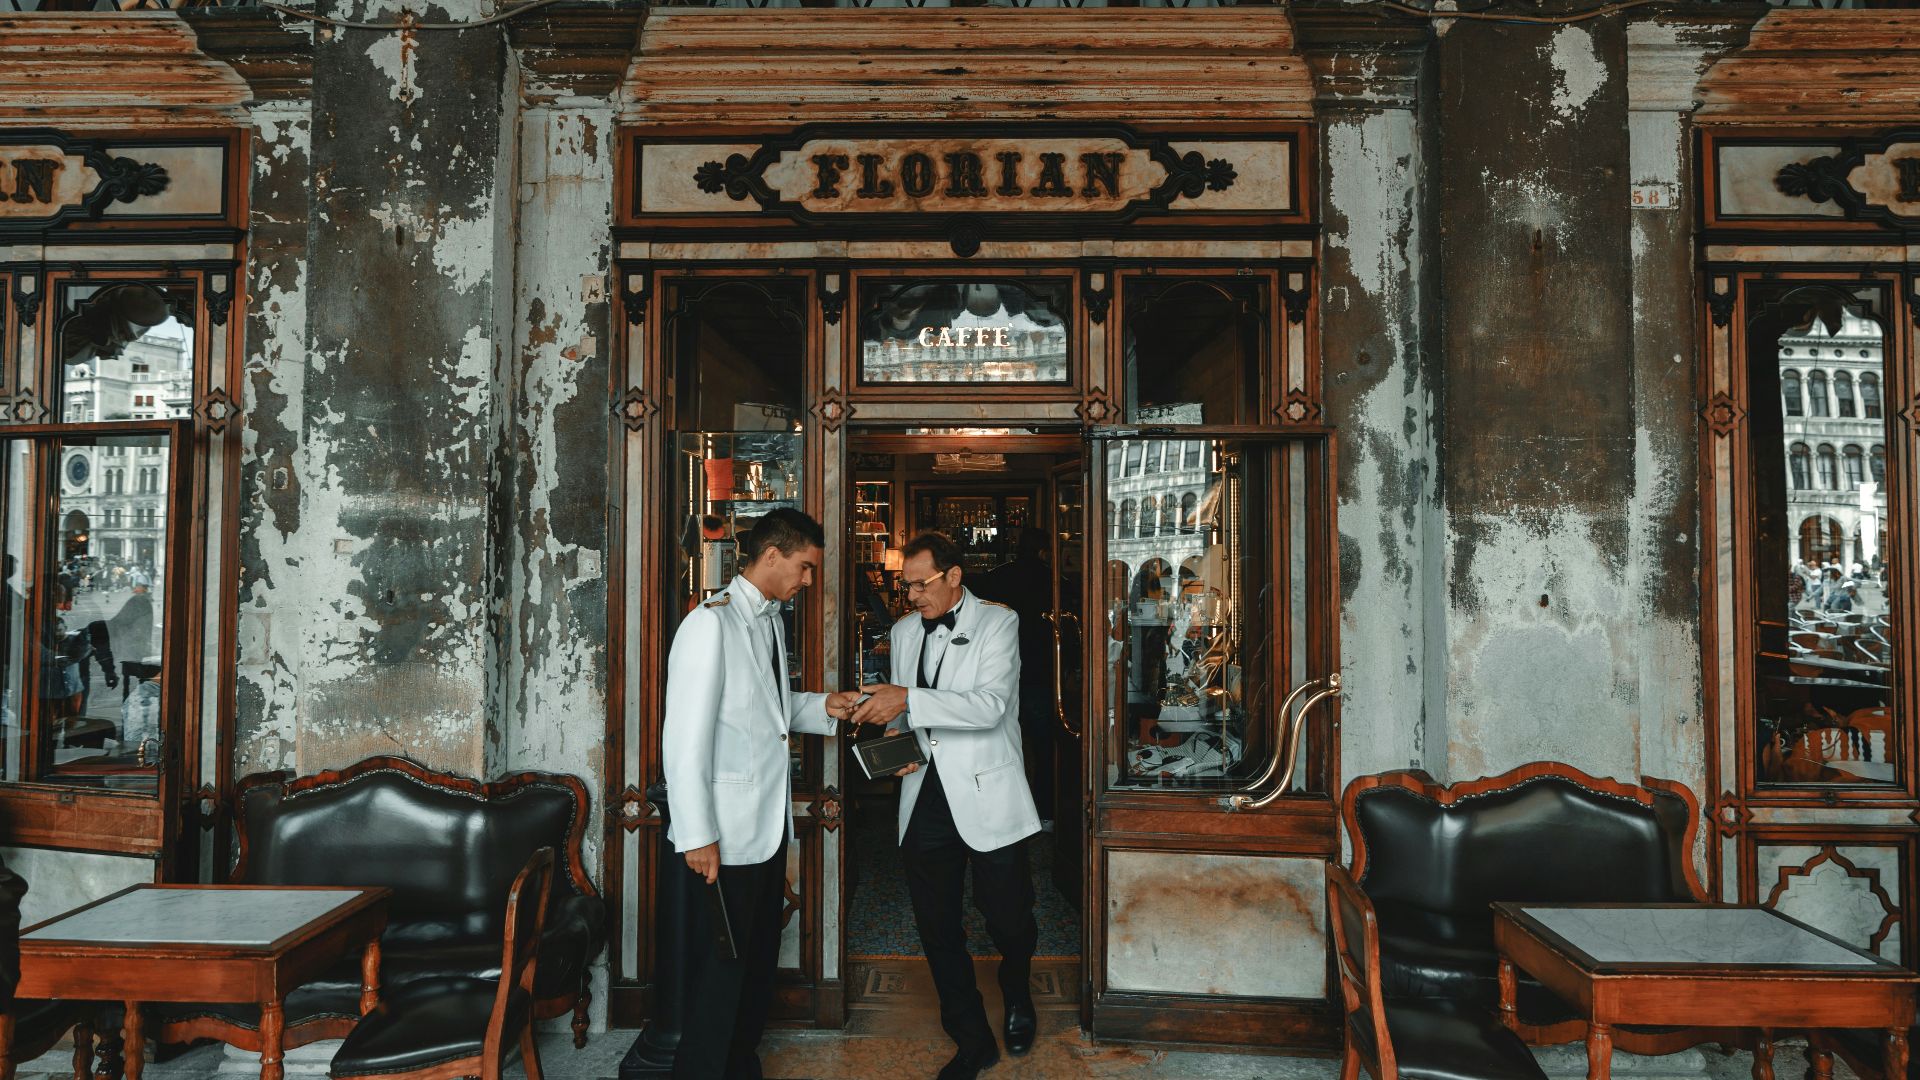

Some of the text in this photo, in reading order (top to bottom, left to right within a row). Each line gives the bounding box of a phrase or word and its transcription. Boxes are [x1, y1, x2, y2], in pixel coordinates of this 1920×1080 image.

[0, 159, 59, 204] N
[812, 151, 1126, 198] FLORIAN
[1632, 190, 1659, 205] 58
